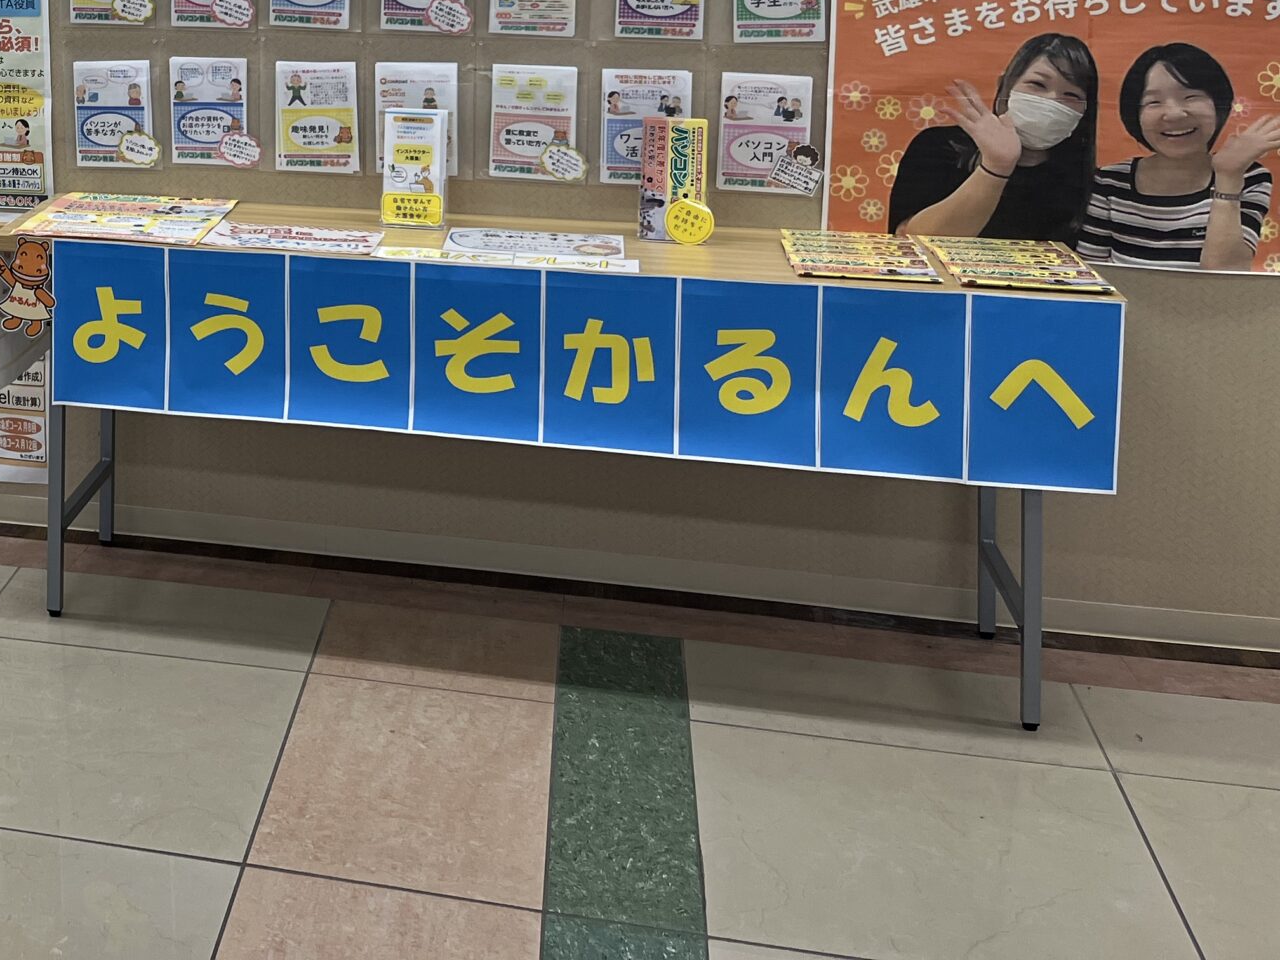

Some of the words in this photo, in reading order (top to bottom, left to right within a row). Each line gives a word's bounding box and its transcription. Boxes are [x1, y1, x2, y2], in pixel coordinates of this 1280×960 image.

[86, 128, 124, 137] 苦手な方へ
[738, 140, 786, 150] パソコン
[750, 152, 773, 163] 入門
[71, 285, 1097, 430] ようこそかるんへ
